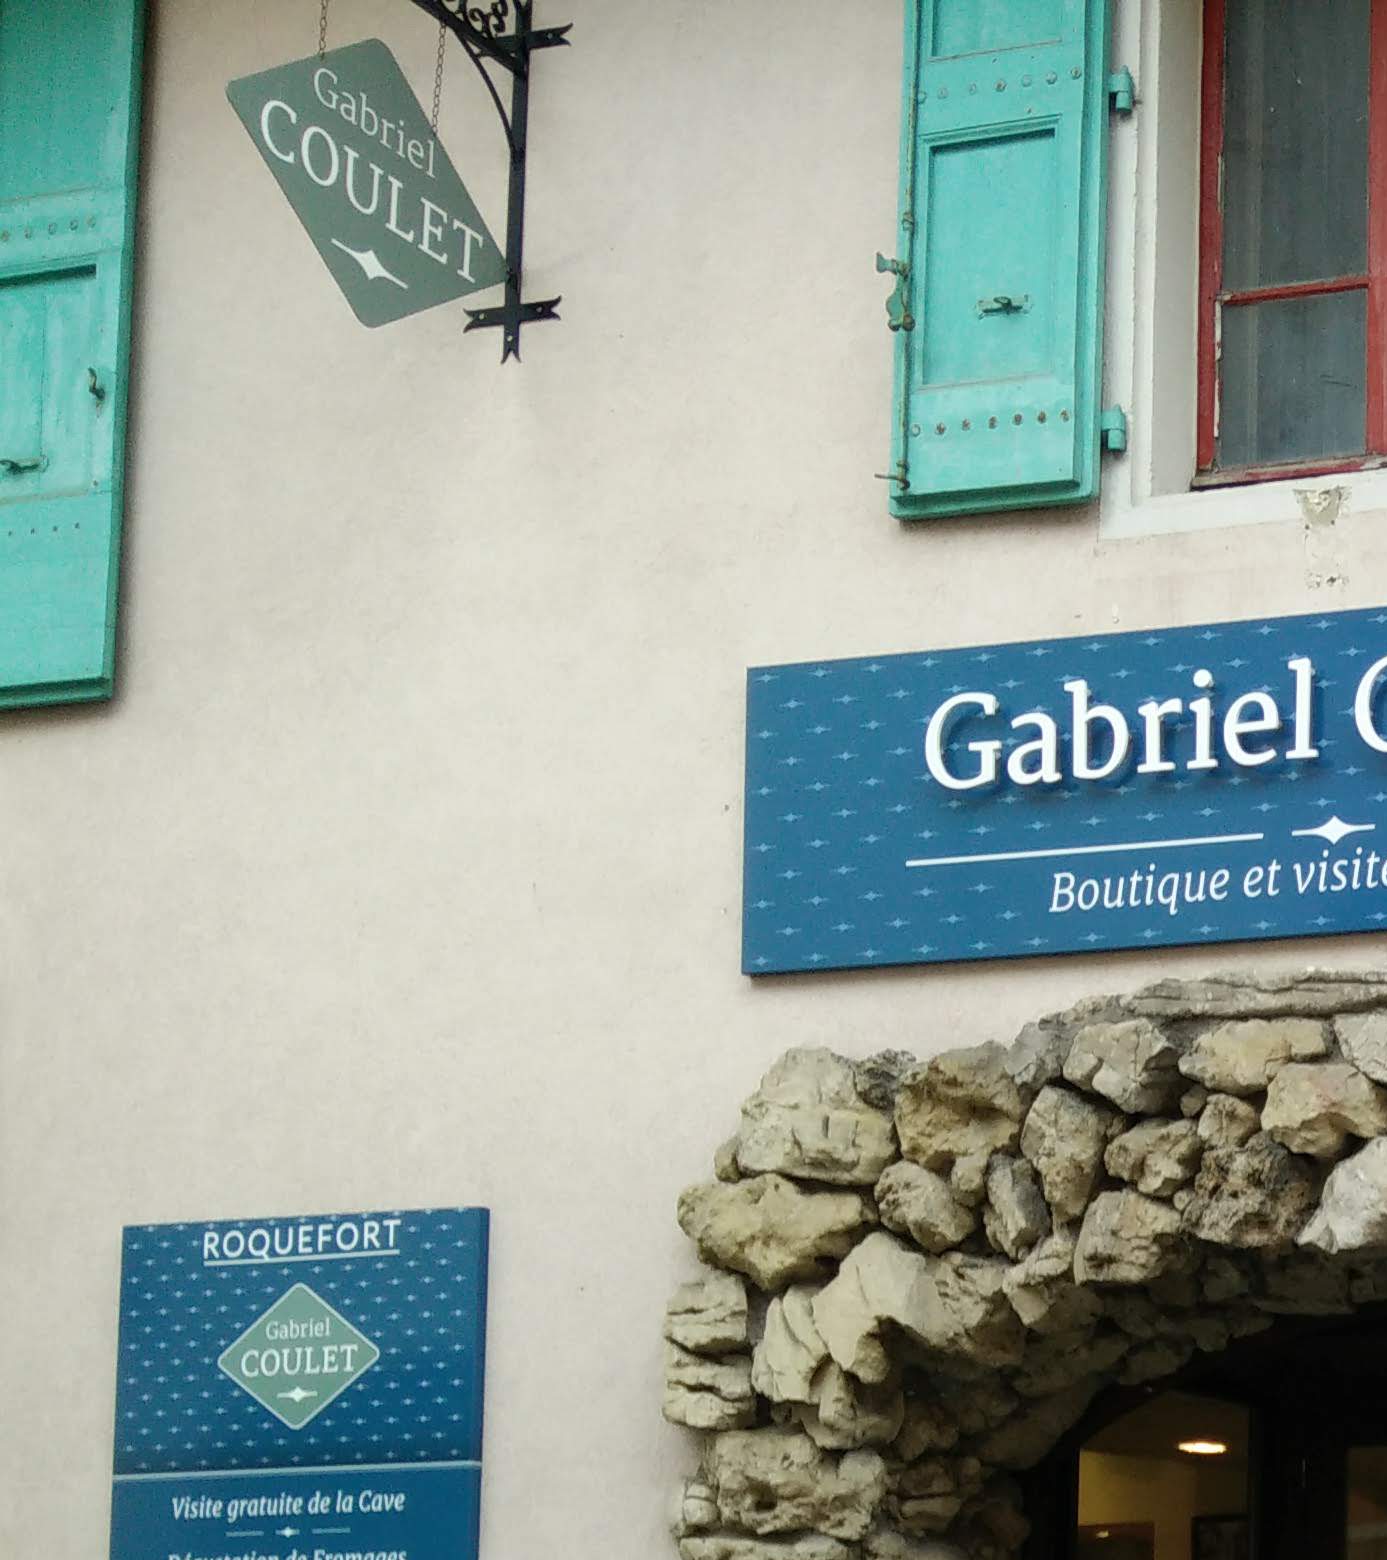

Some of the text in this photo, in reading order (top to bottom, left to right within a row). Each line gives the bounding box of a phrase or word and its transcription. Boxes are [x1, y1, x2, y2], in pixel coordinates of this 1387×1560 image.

[314, 68, 436, 178] Gabriel
[261, 100, 484, 283] COULET
[924, 658, 1319, 791] Gabriel
[1048, 870, 1230, 917] Boutique
[1242, 857, 1281, 898] et
[203, 1218, 402, 1261] ROQUEFORT
[265, 1317, 330, 1341] Gabriel
[241, 1343, 359, 1378] COULET
[172, 1489, 406, 1523] Visite gratuite de la Cave
